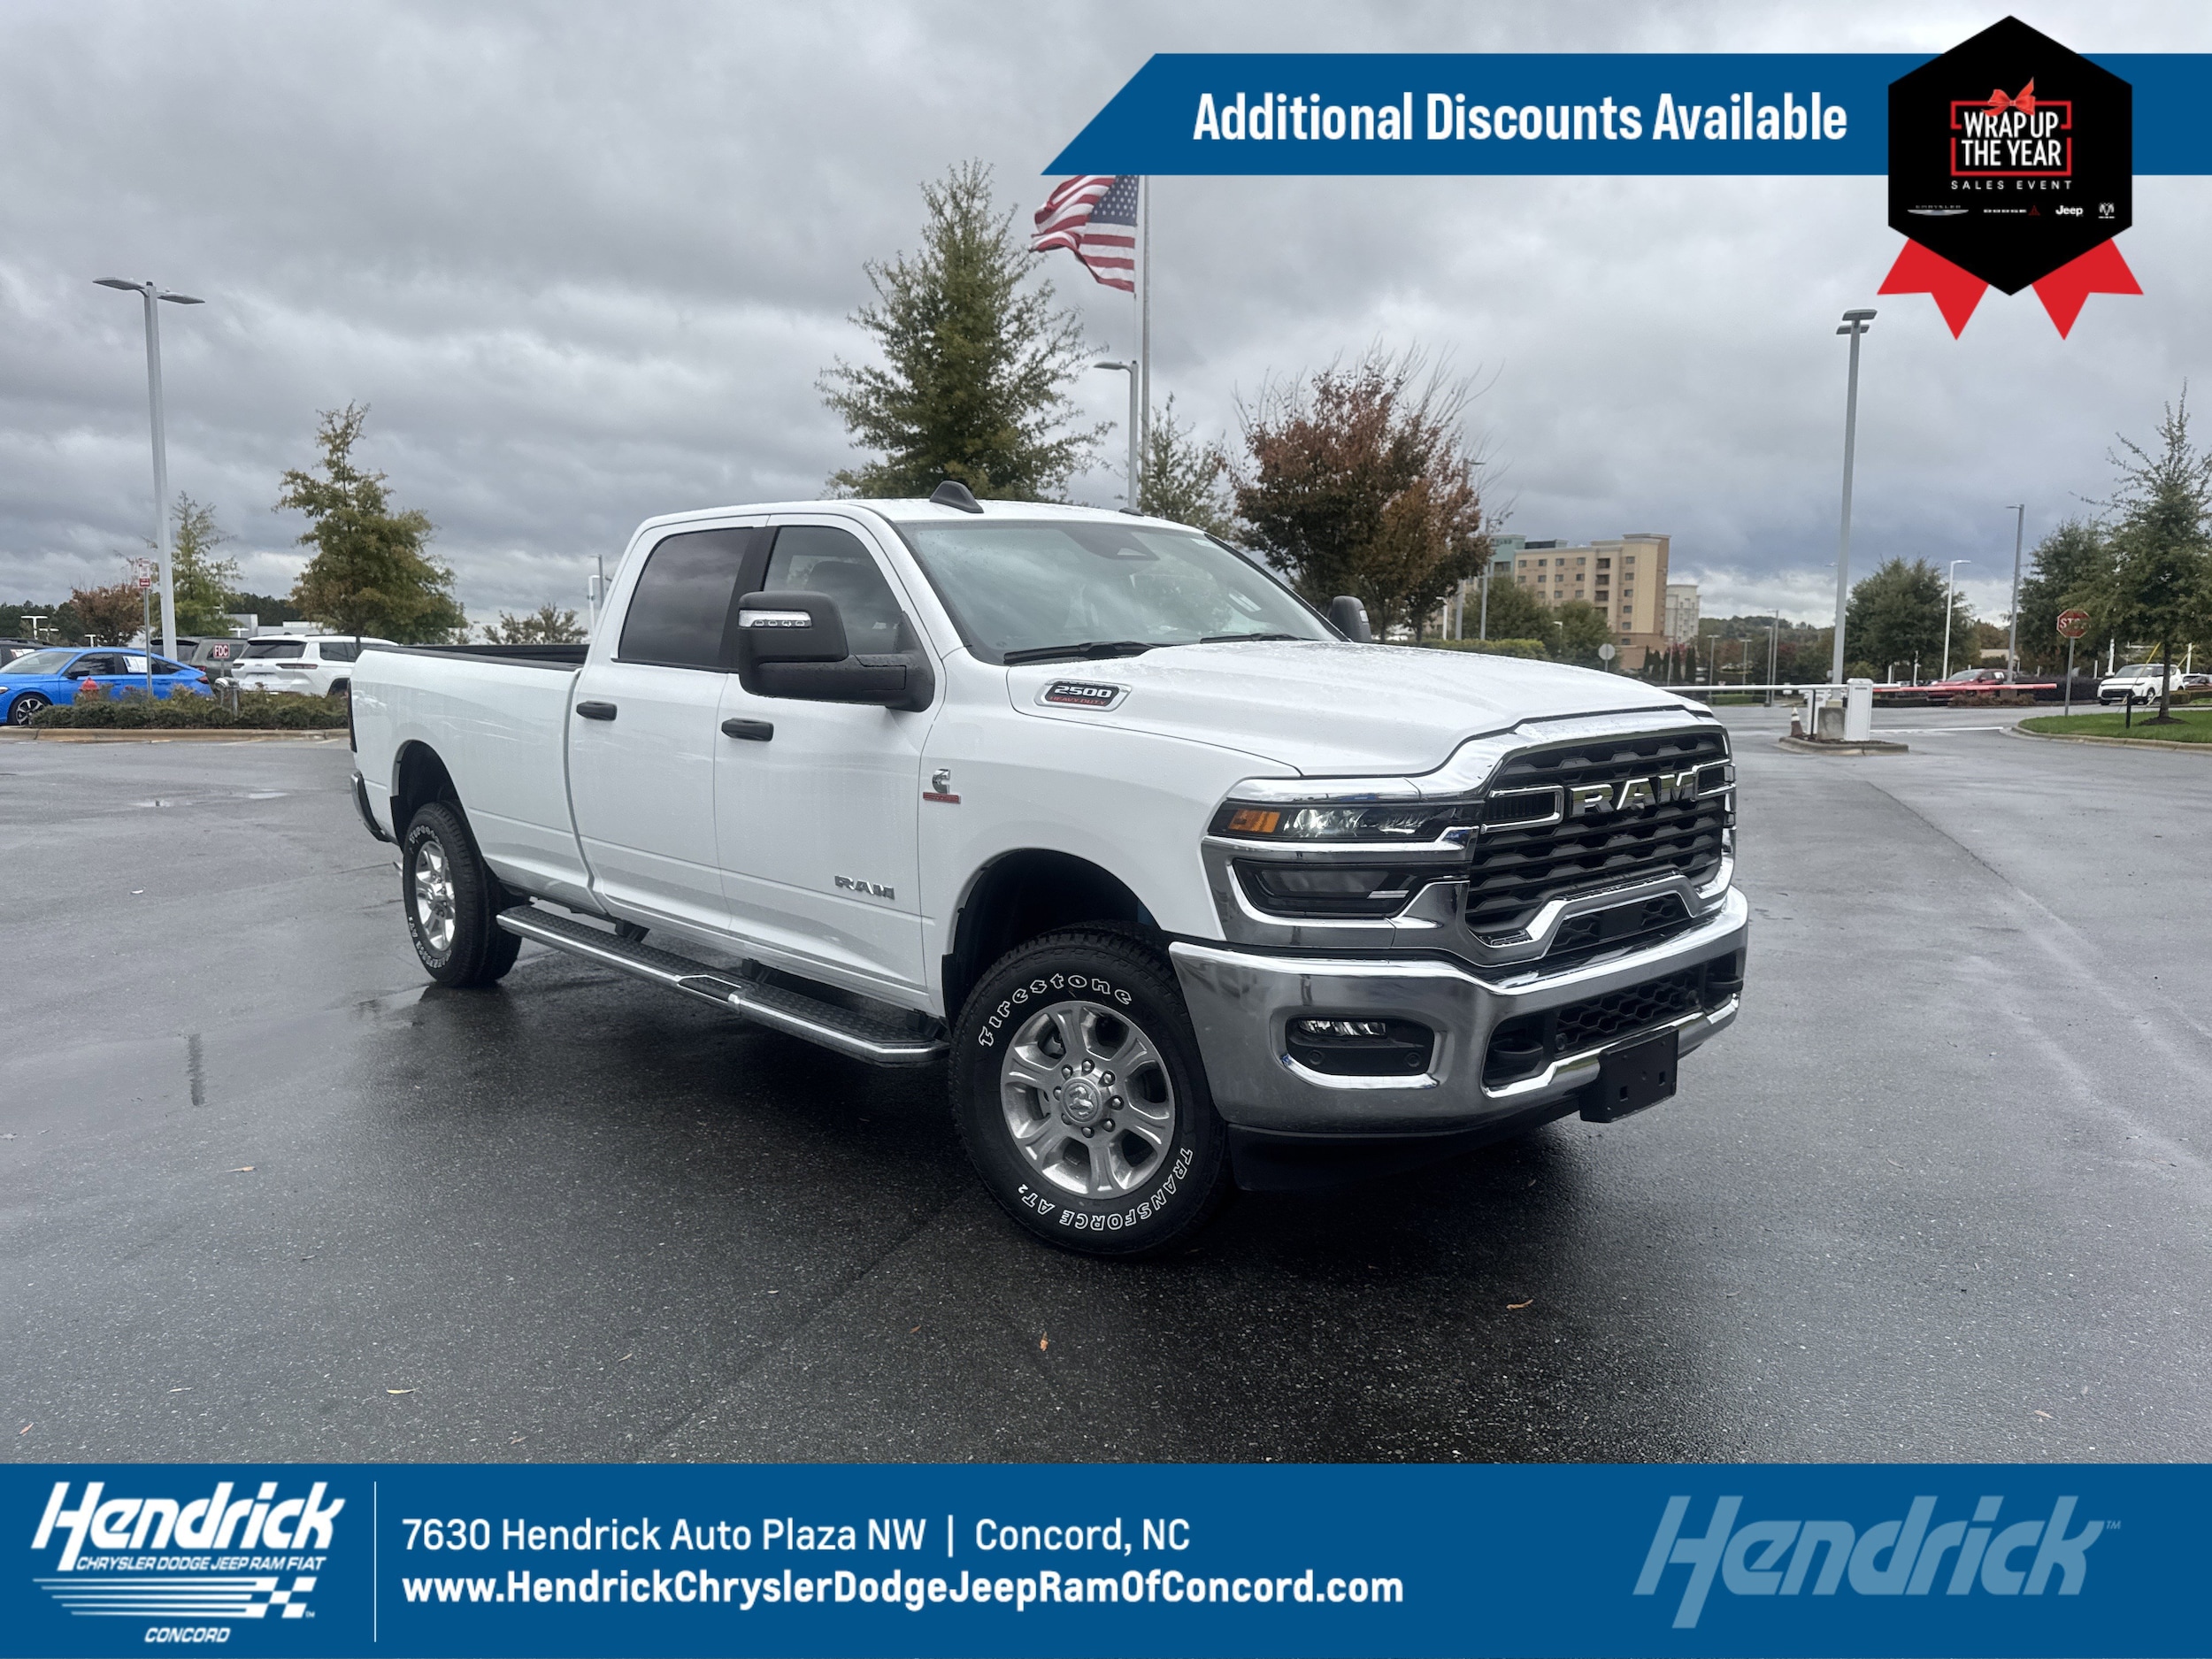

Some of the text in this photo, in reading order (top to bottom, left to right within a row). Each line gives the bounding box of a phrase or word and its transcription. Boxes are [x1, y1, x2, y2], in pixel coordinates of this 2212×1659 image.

[214, 645, 228, 657] FDC
[1054, 685, 1112, 699] 2500
[1569, 770, 1698, 819] RAM
[834, 874, 895, 901] RAM
[979, 972, 1133, 1048] Firestone
[1059, 1147, 1194, 1232] TRANSFORCE
